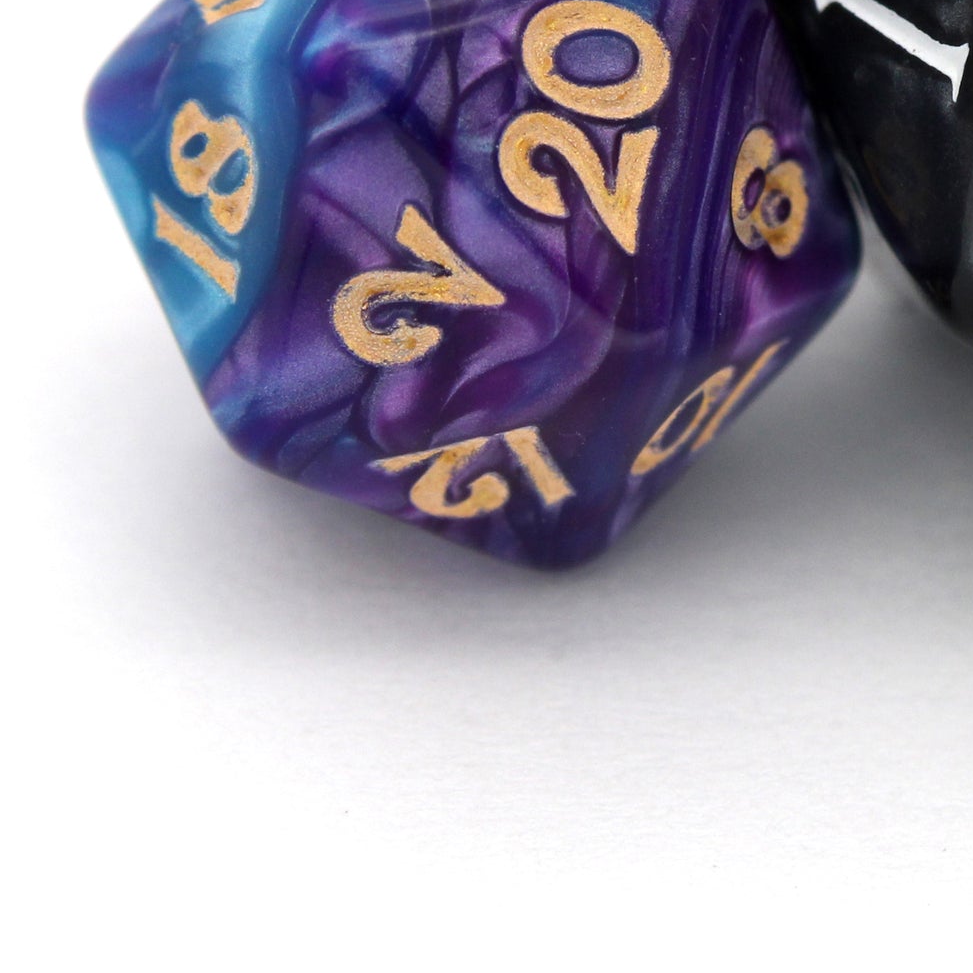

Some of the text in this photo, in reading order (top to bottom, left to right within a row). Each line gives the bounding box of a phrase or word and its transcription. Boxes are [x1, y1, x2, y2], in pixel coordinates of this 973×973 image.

[152, 99, 257, 303] 18
[730, 126, 810, 259] 8
[332, 204, 507, 367] 2
[368, 426, 578, 520] 12
[631, 341, 790, 476] 10
